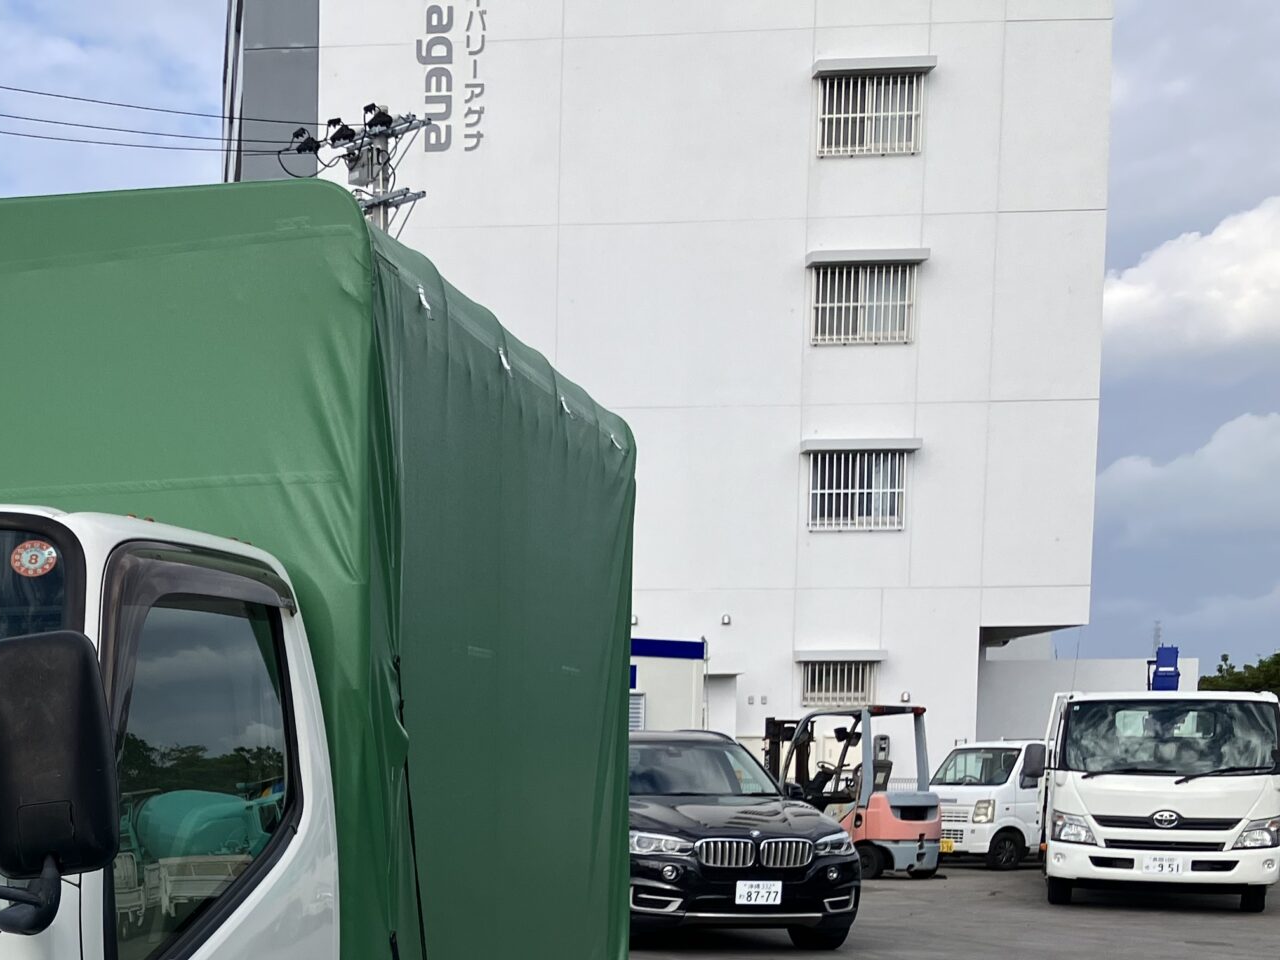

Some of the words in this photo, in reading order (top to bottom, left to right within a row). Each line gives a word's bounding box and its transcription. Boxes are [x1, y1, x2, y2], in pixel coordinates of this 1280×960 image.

[416, 4, 454, 153] agena
[464, 0, 487, 152] バリーアグナ
[746, 890, 779, 902] 87-77
